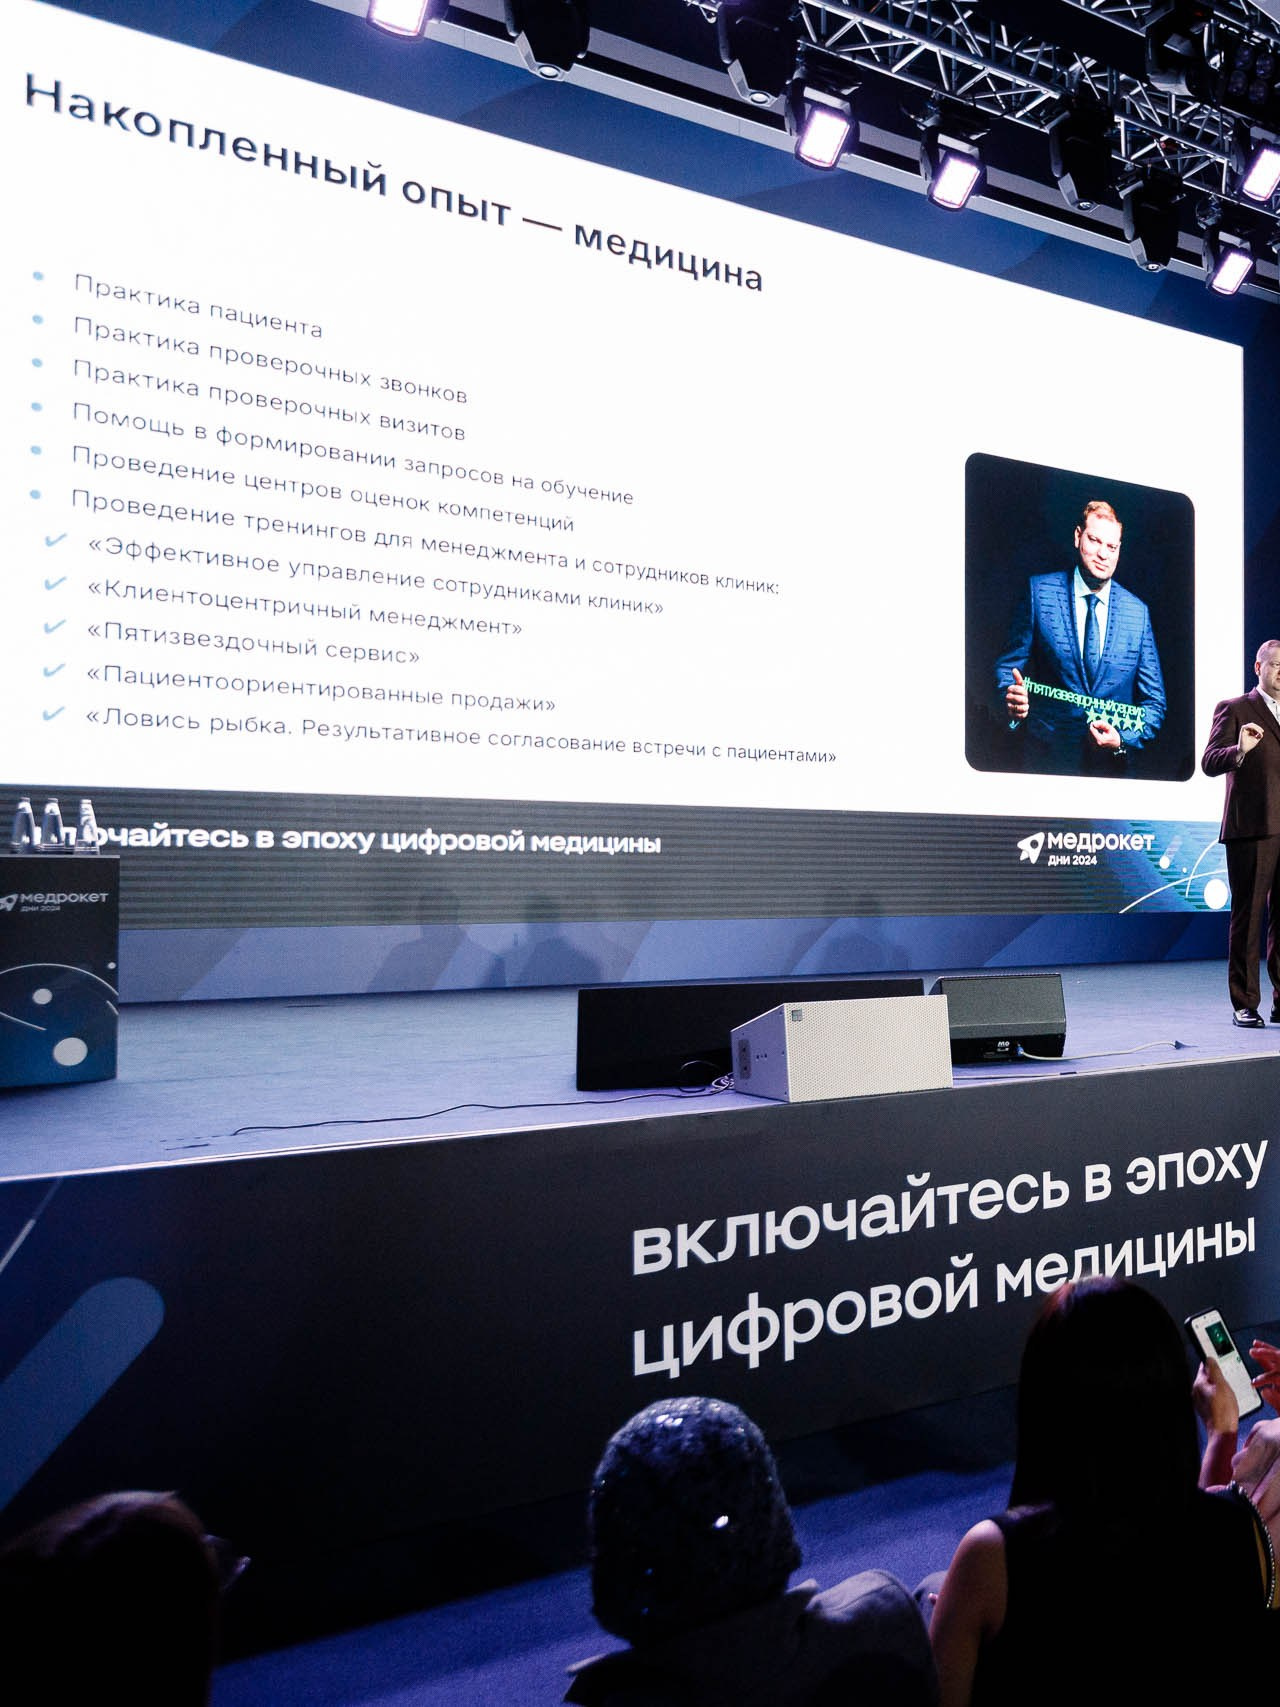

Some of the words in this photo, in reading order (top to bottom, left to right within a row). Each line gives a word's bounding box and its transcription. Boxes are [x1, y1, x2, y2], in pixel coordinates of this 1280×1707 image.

[25, 73, 388, 197] Накопленный
[403, 180, 511, 227] опыт
[574, 222, 764, 292] медицина
[75, 273, 200, 314] Практика
[210, 304, 322, 339] пациента
[74, 316, 200, 356] Практика
[209, 345, 371, 387] проверочных
[379, 376, 468, 404] звонков
[74, 359, 199, 397] Практика
[209, 385, 371, 425] проверочных
[379, 415, 465, 441] визитов
[73, 401, 185, 438] Помощь
[194, 425, 208, 440] в
[216, 425, 396, 469] формировании
[404, 458, 504, 485] запросов
[511, 475, 534, 490] на
[540, 479, 634, 505] обучение
[73, 444, 236, 485] Проведение
[244, 474, 342, 500] центров
[350, 489, 430, 512] оценок
[438, 501, 574, 532] компетенций
[72, 488, 235, 527] Проведение
[243, 514, 367, 543] тренингов
[373, 532, 413, 549] для
[421, 537, 568, 568] менеджмента
[575, 557, 586, 571] и
[592, 559, 710, 586] сотрудников
[715, 575, 779, 595] клиник:
[88, 536, 280, 573] «Эффективное
[288, 561, 425, 589] управление
[433, 577, 581, 606] сотрудниками
[588, 595, 664, 614] клиник»
[87, 621, 317, 657] «Пятизвездочный
[325, 644, 420, 664] сервис»
[88, 579, 361, 621] «Клиентоцентричный
[369, 609, 523, 635] менеджмент»
[87, 664, 444, 705] «Пациентоориентированные
[451, 693, 556, 712] продажи»
[85, 707, 200, 730] «Ловись
[210, 716, 292, 735] рыбка.
[302, 719, 481, 745] Результативное
[487, 733, 626, 753] согласование
[632, 741, 706, 759] встречи
[711, 745, 721, 758] с
[727, 746, 837, 764] пациентами»
[256, 830, 274, 848] в
[282, 831, 375, 854] эпоху
[381, 828, 525, 856] цифровой
[530, 835, 661, 856] медицины
[1047, 832, 1155, 853] медрокет
[1073, 854, 1098, 866] 2024
[19, 892, 109, 905] медрокет
[633, 1171, 1070, 1276] включайтесь
[1084, 1163, 1112, 1203] в
[1126, 1139, 1269, 1197] эпоху
[633, 1252, 979, 1380] цифровой
[996, 1216, 1256, 1304] медицины
